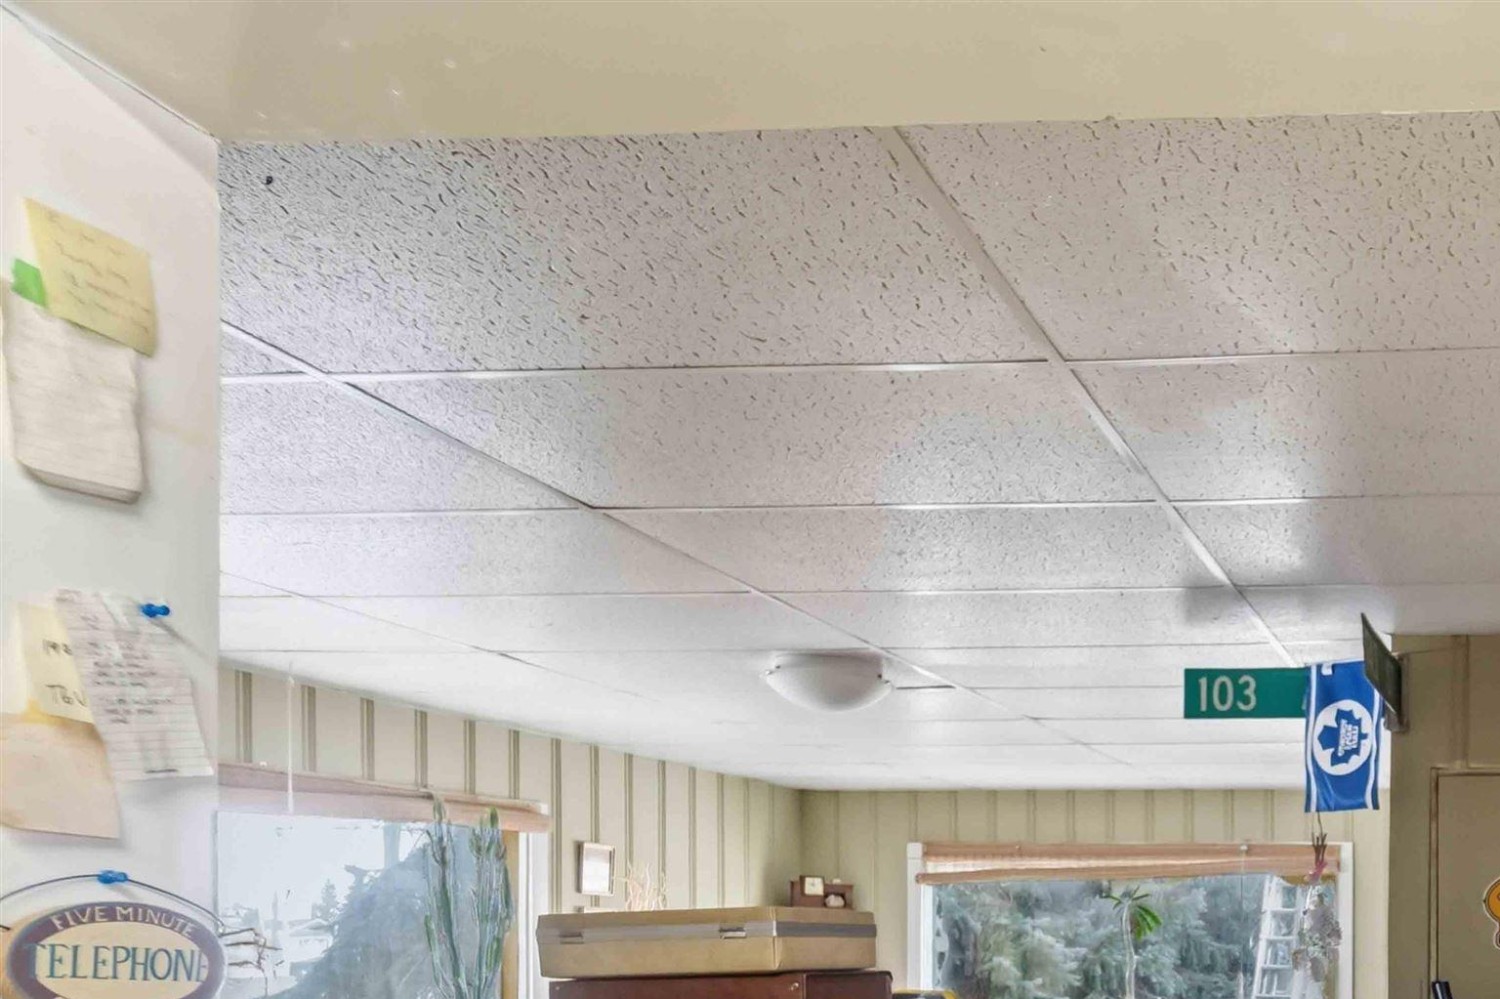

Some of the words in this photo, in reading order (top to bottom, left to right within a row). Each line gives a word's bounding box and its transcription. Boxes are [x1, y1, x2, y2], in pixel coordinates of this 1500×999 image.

[1198, 674, 1257, 711] 103
[50, 906, 107, 931] FIVE
[116, 906, 198, 937] MINUTE
